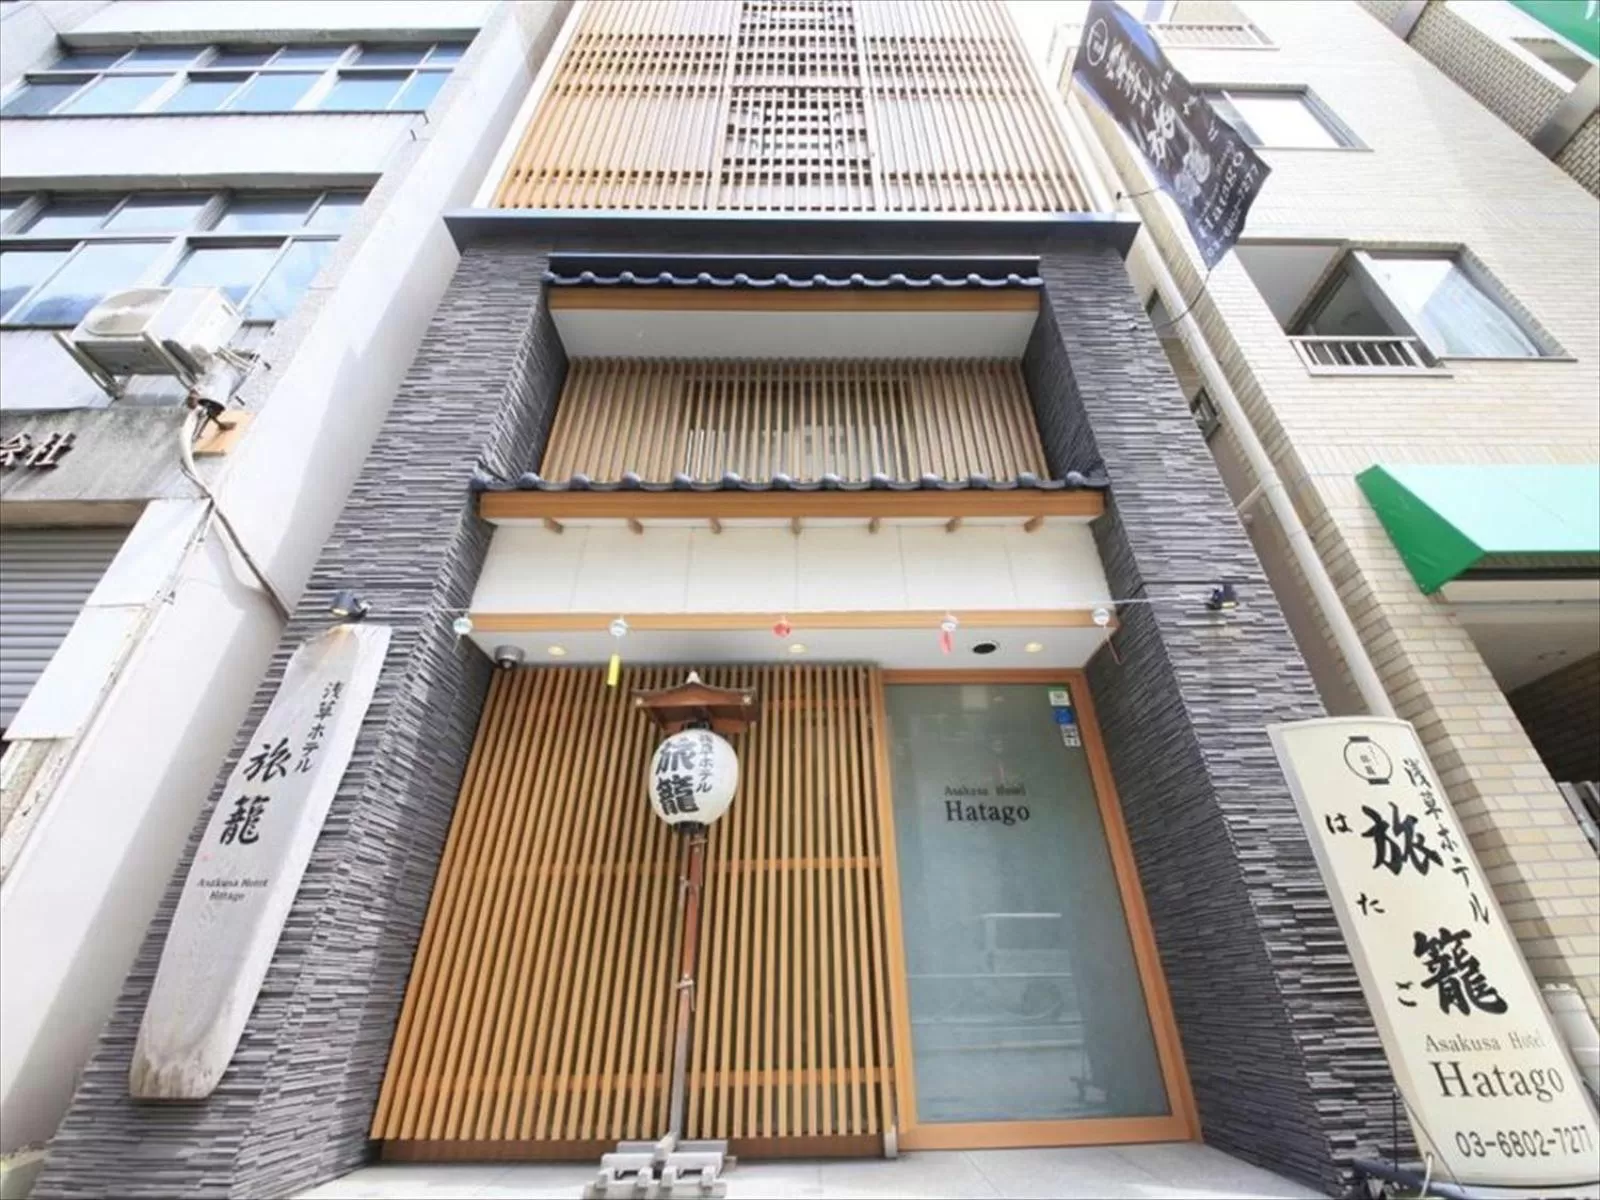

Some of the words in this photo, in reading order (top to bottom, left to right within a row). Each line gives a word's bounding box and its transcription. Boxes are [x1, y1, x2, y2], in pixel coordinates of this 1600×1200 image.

[294, 680, 345, 774] 浅草ホテル
[219, 736, 292, 846] 旅籠
[655, 736, 700, 817] 旅籠
[944, 799, 1031, 827] Hatago
[1403, 757, 1490, 925] 浅草ホテル
[1425, 1033, 1502, 1054] Asakusa
[1508, 1028, 1546, 1050] Hotel
[1430, 1060, 1566, 1103] Hatago
[1455, 1124, 1594, 1158] 03-6802-7277
